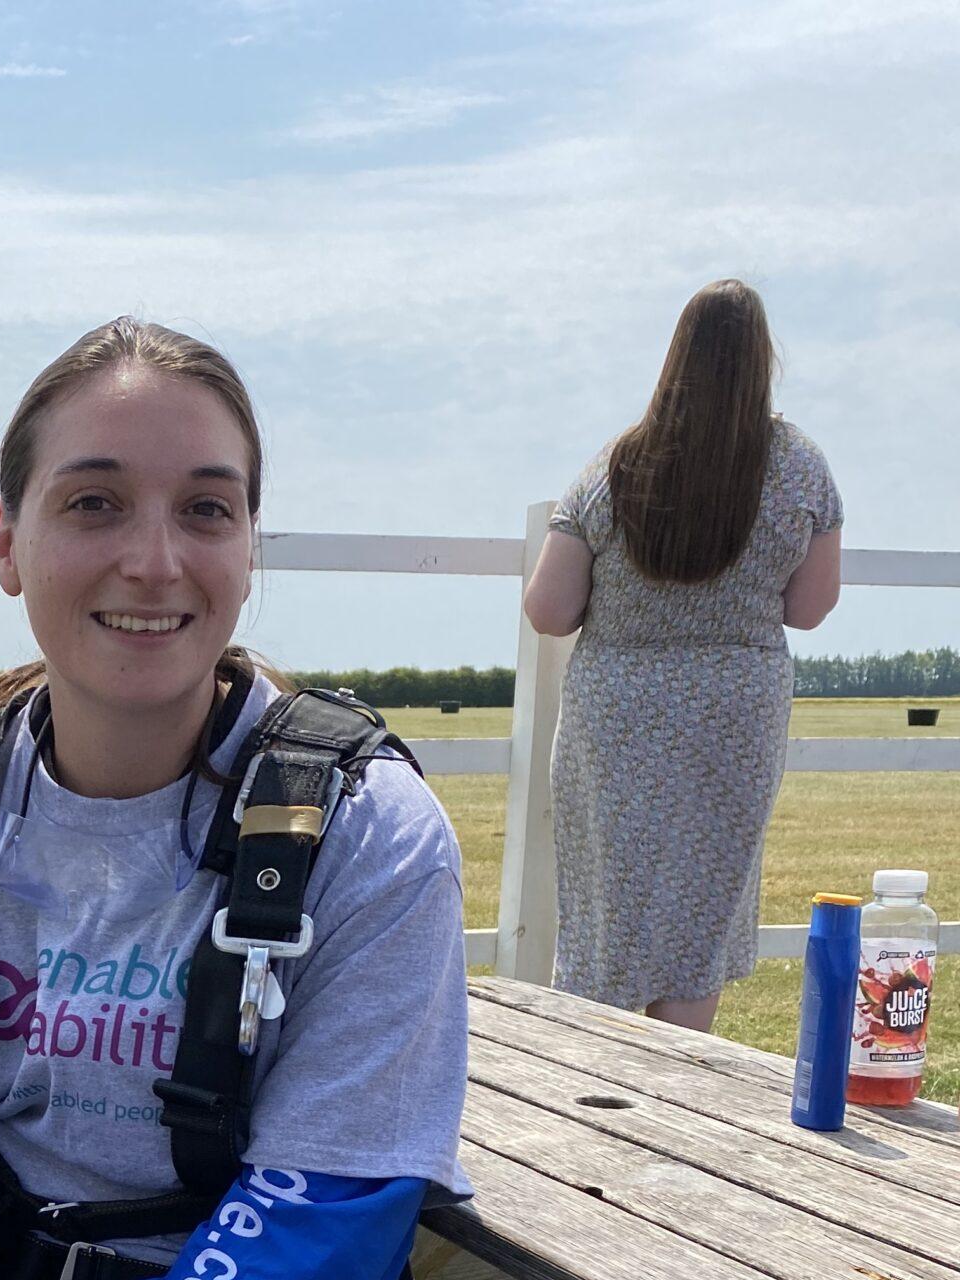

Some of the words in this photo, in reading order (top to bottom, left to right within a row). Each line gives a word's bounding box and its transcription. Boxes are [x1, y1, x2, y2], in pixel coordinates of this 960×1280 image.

[890, 1008, 926, 1027] BURST
[26, 1000, 181, 1071] abilit
[50, 1091, 106, 1115] abled
